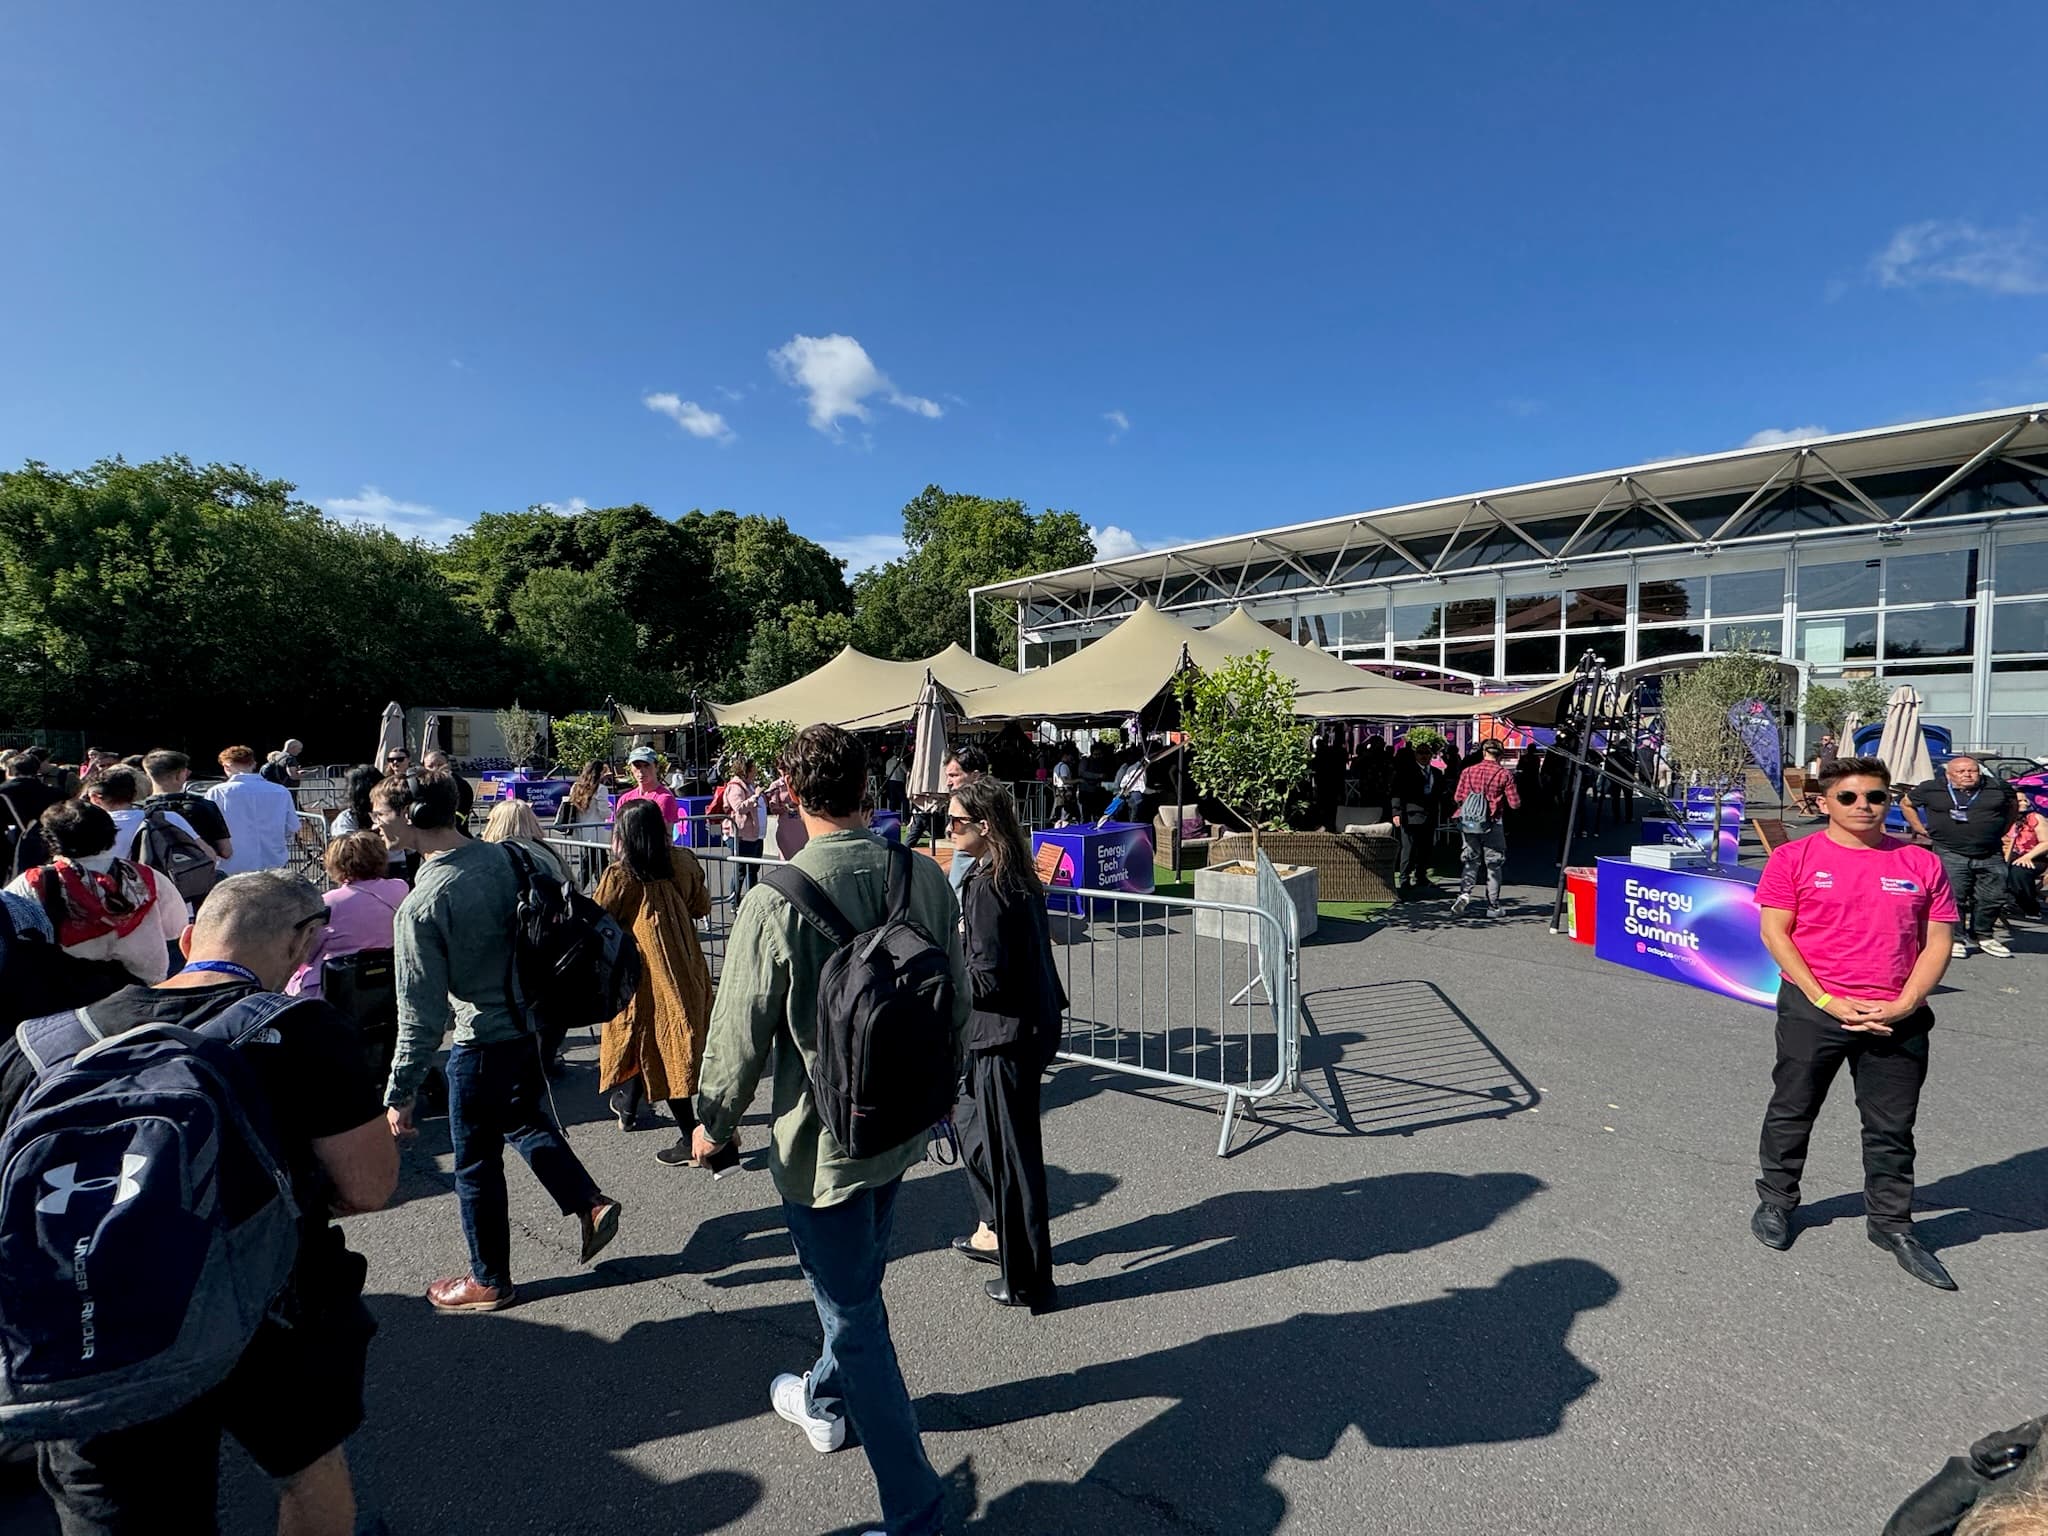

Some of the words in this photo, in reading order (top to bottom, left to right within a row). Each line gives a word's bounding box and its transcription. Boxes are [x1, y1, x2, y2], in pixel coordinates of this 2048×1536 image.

[1097, 844, 1126, 858] Energy
[1097, 857, 1119, 873] Tech
[1098, 868, 1129, 886] Summit
[1625, 878, 1693, 913] Energy
[1624, 898, 1672, 925] Tech
[1624, 916, 1700, 951] Summit
[74, 1236, 91, 1291] UNDER
